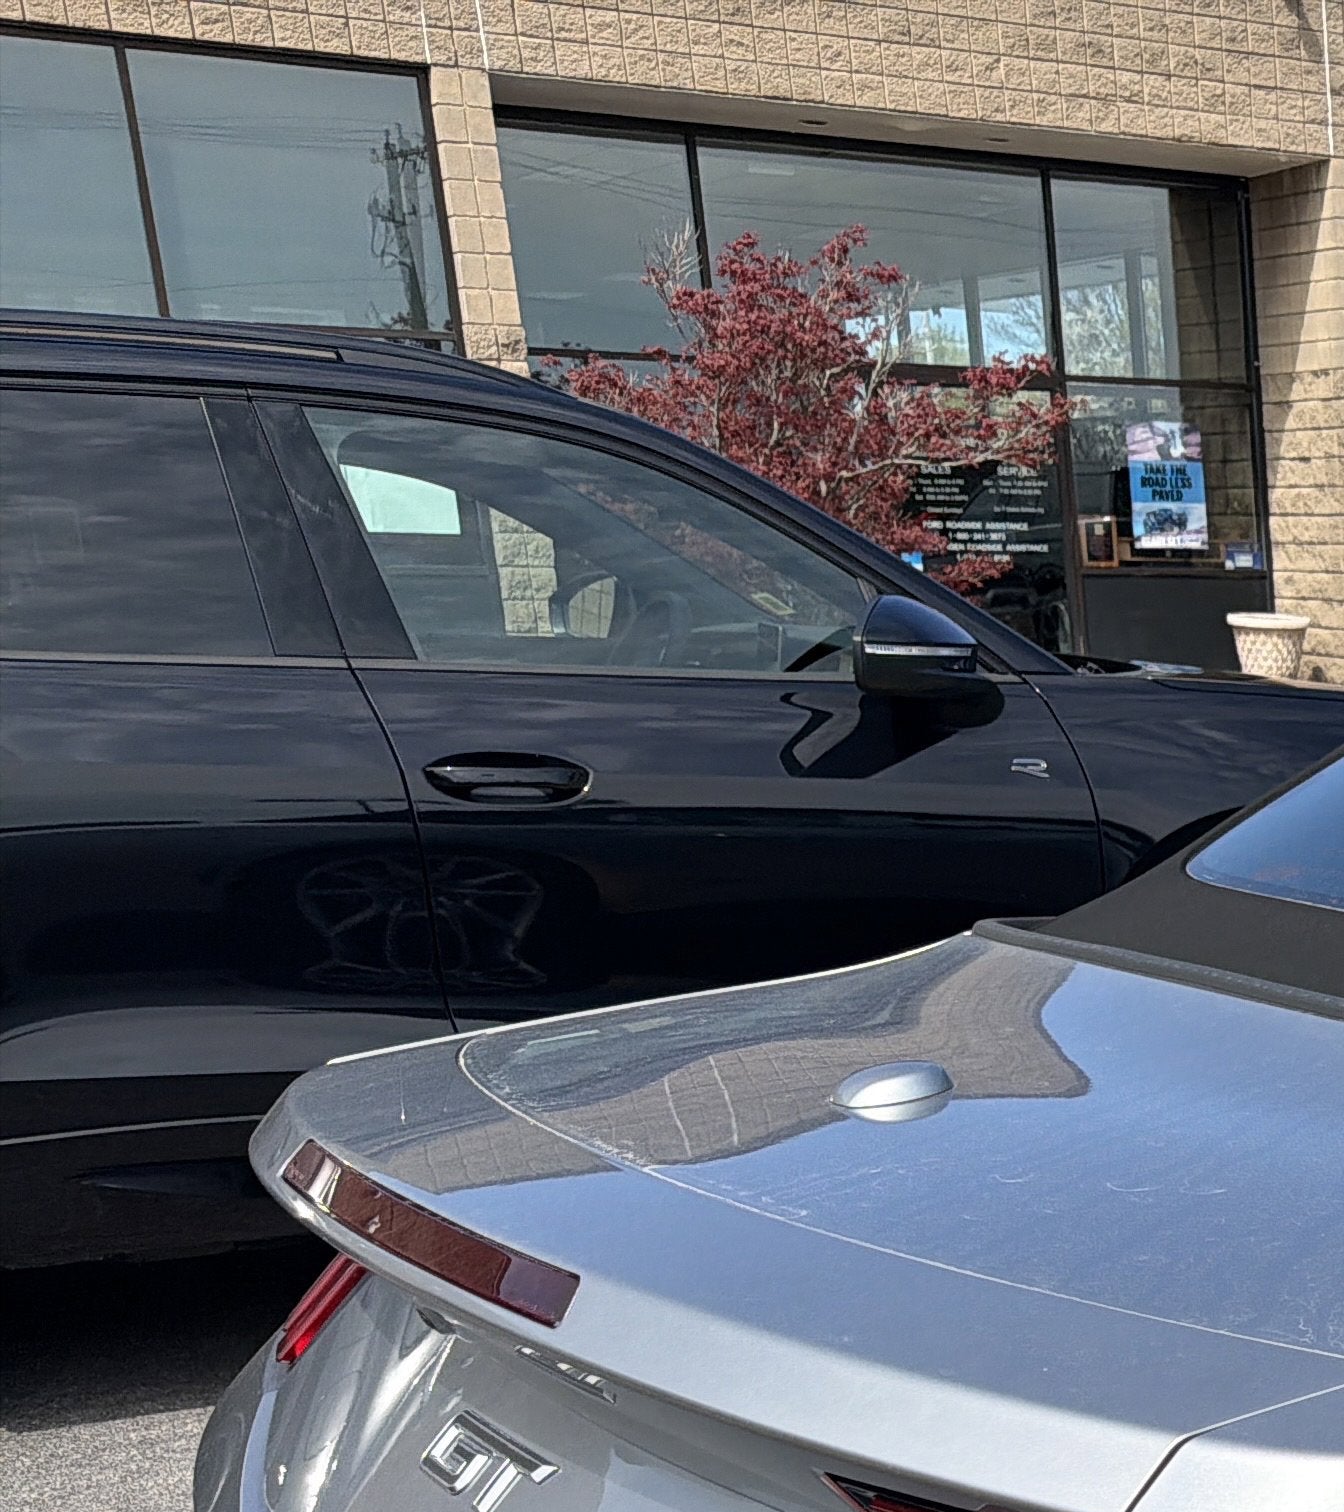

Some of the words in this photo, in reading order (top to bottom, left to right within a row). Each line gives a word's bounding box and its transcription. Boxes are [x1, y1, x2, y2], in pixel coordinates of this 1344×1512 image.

[1144, 463, 1168, 477] TAKE
[1170, 463, 1187, 477] THE
[1140, 476, 1168, 489] ROAD
[1169, 476, 1193, 489] LESS
[1151, 489, 1184, 501] PAVED
